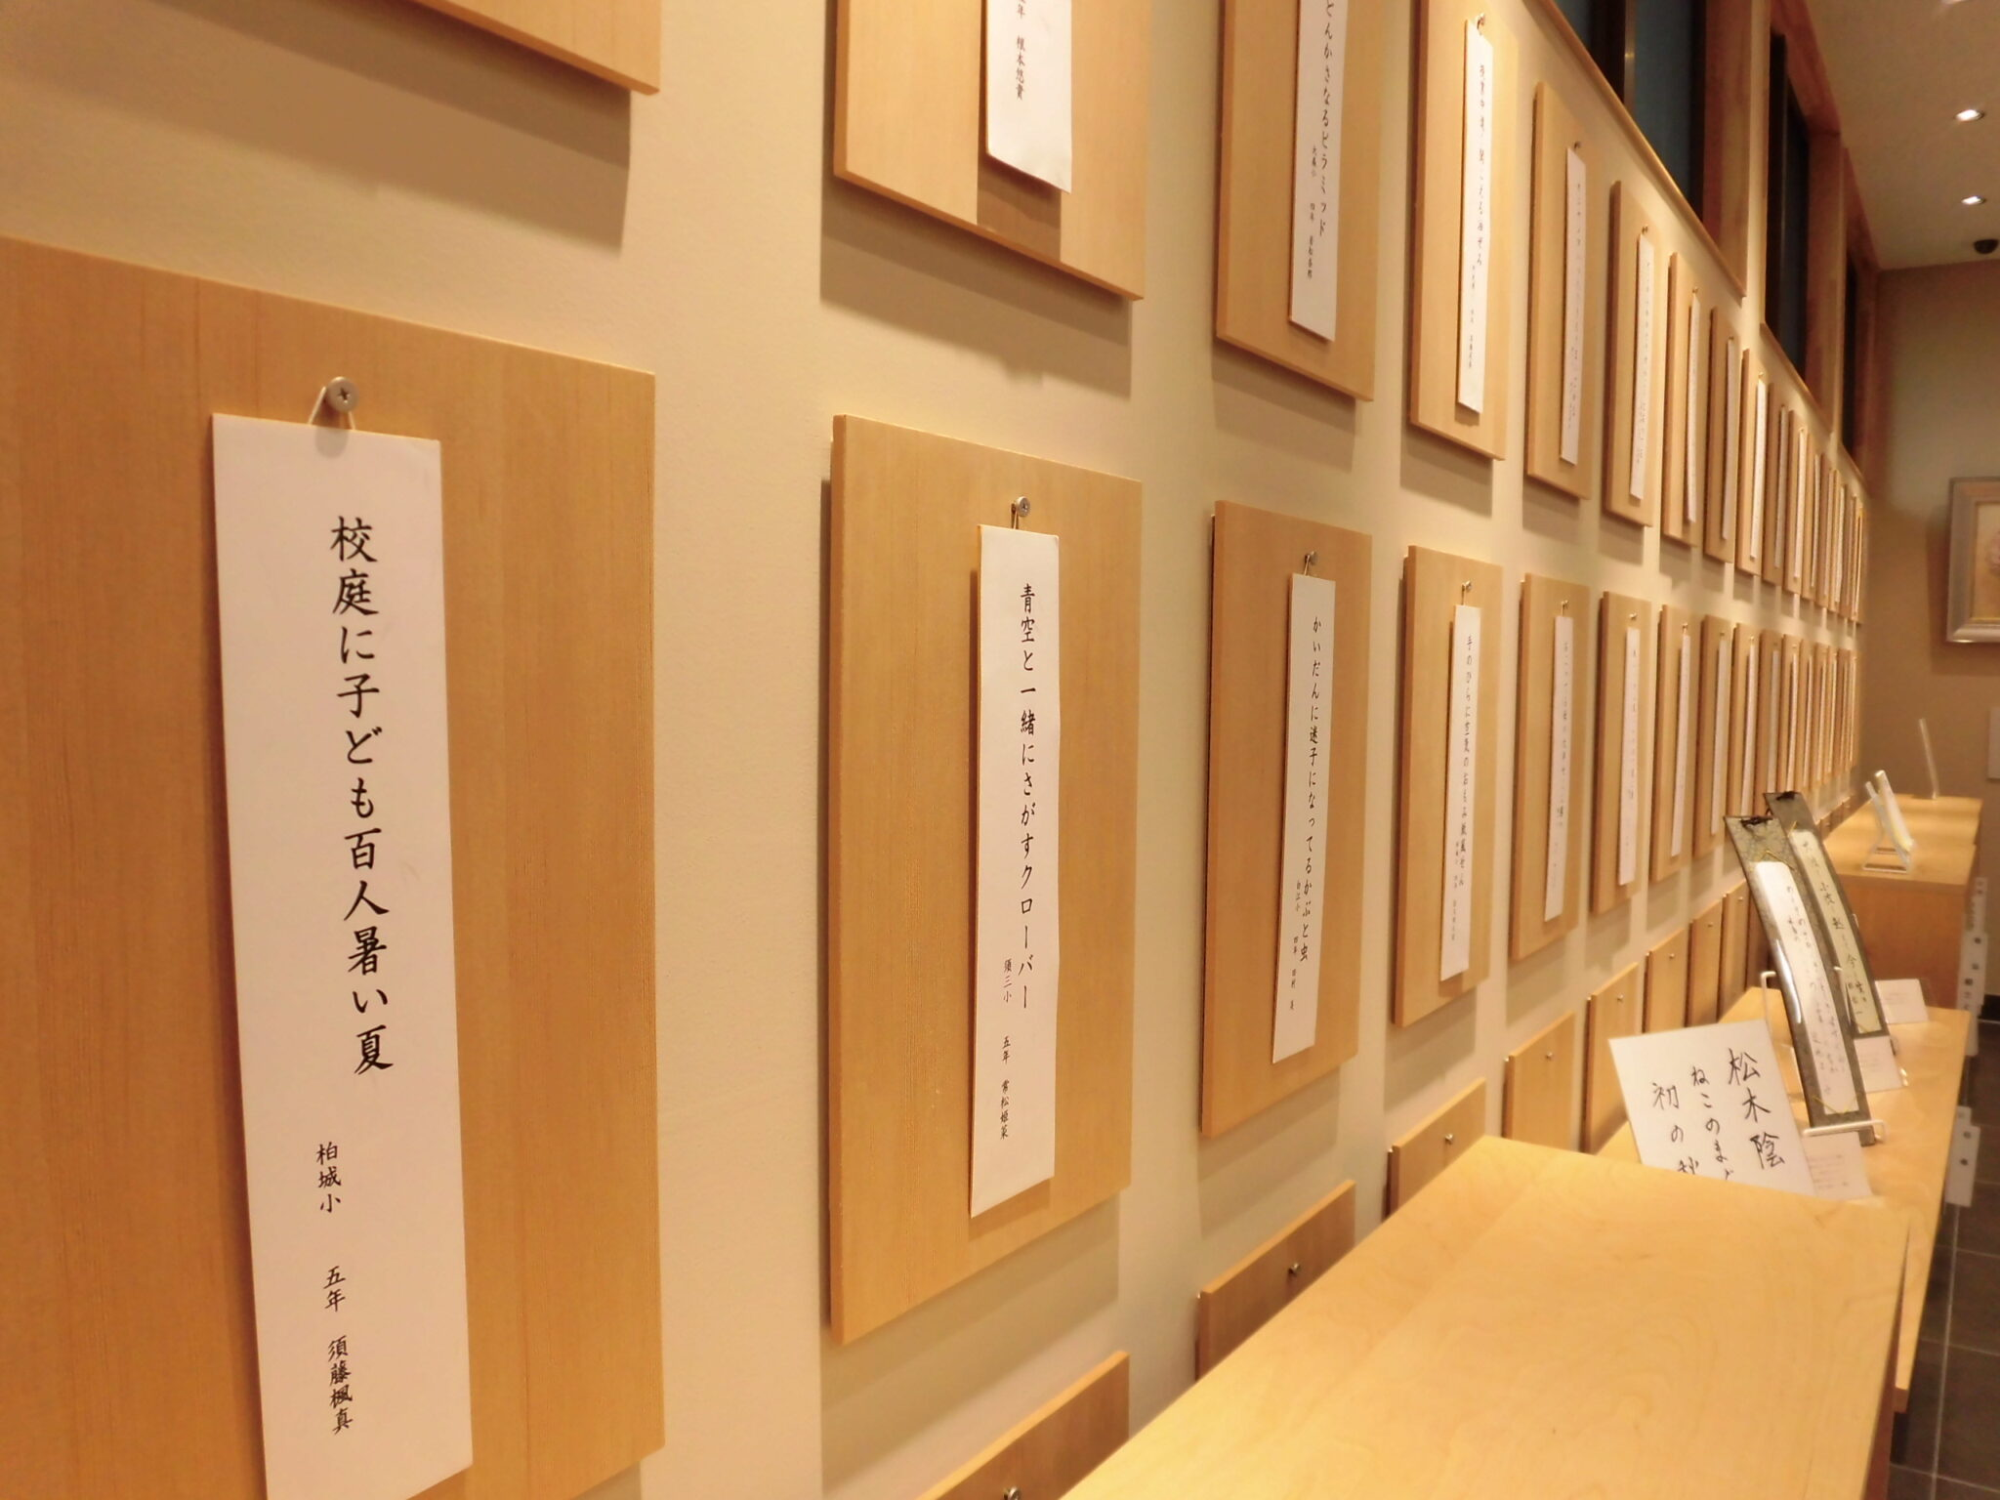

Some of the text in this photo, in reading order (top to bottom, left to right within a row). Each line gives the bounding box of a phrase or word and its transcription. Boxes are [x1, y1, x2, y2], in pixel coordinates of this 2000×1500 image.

[330, 515, 394, 1076] 校庭に子ども百人暑い夏
[1018, 583, 1037, 1009] 青空と一緒にさがすクローバー
[315, 1141, 342, 1214] 柏城小
[323, 1265, 347, 1312] 五年
